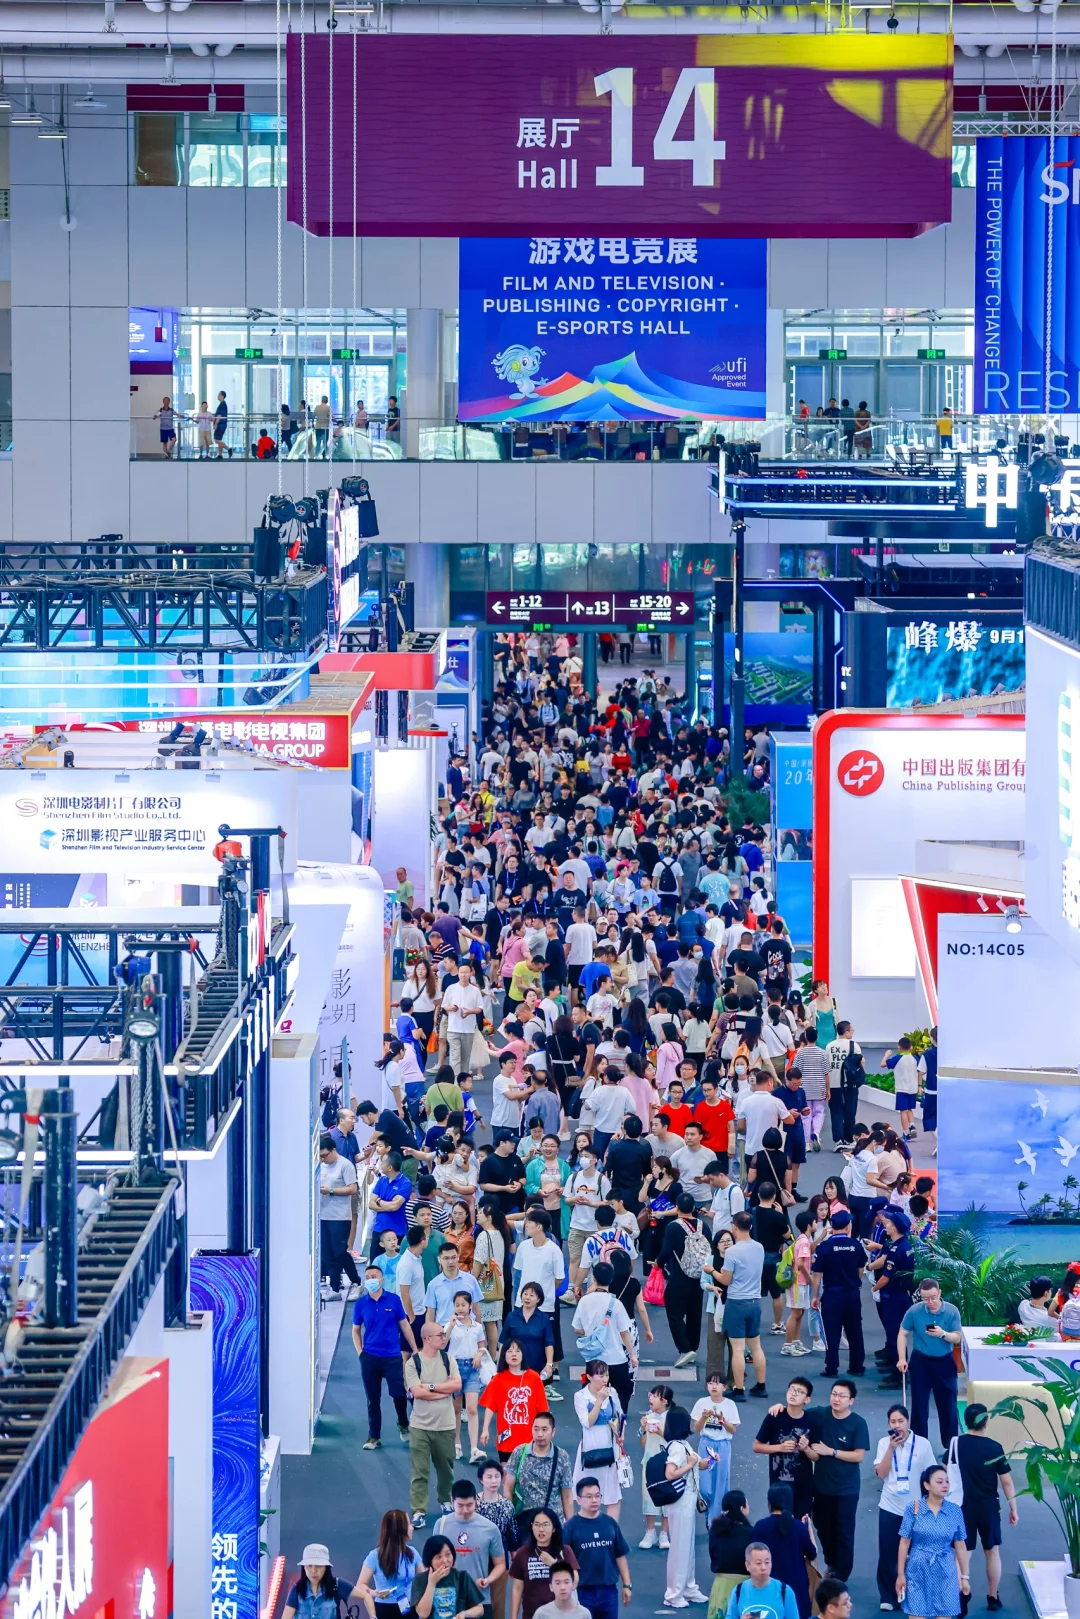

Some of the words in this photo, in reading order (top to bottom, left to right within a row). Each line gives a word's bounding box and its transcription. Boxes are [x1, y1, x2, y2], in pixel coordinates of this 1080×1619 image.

[516, 118, 580, 148] 展厅
[594, 67, 726, 186] 14
[518, 158, 577, 188] Hall
[987, 156, 1002, 192] THE
[986, 198, 1002, 262] POWER
[529, 237, 698, 265] 游戏电竞展
[502, 276, 548, 290] FILM
[554, 276, 595, 290] AND
[601, 276, 714, 290] TELEVISION
[985, 266, 1001, 288] OF
[483, 299, 601, 313] PUBLISHING
[617, 298, 729, 312] COPYRIGHT
[537, 320, 634, 335] E-SPORTS
[640, 320, 691, 335] HALL
[984, 295, 1001, 369] CHANGE
[727, 357, 747, 373] ufi
[711, 373, 747, 382] Approved
[726, 380, 747, 388] Event
[984, 371, 1080, 409] RES
[519, 595, 543, 608] 1-12
[594, 601, 610, 616] 13
[640, 595, 672, 608] 15-20
[273, 743, 325, 758] GROUP
[902, 780, 933, 791] China
[937, 780, 992, 793] Publishing
[43, 796, 182, 810] 深圳电影制片厂有限公司
[61, 828, 206, 842] 深圳影视产业服务中心
[141, 844, 165, 852] Industry
[947, 943, 1025, 956] NO:14C05
[211, 1532, 239, 1619] 领先的
